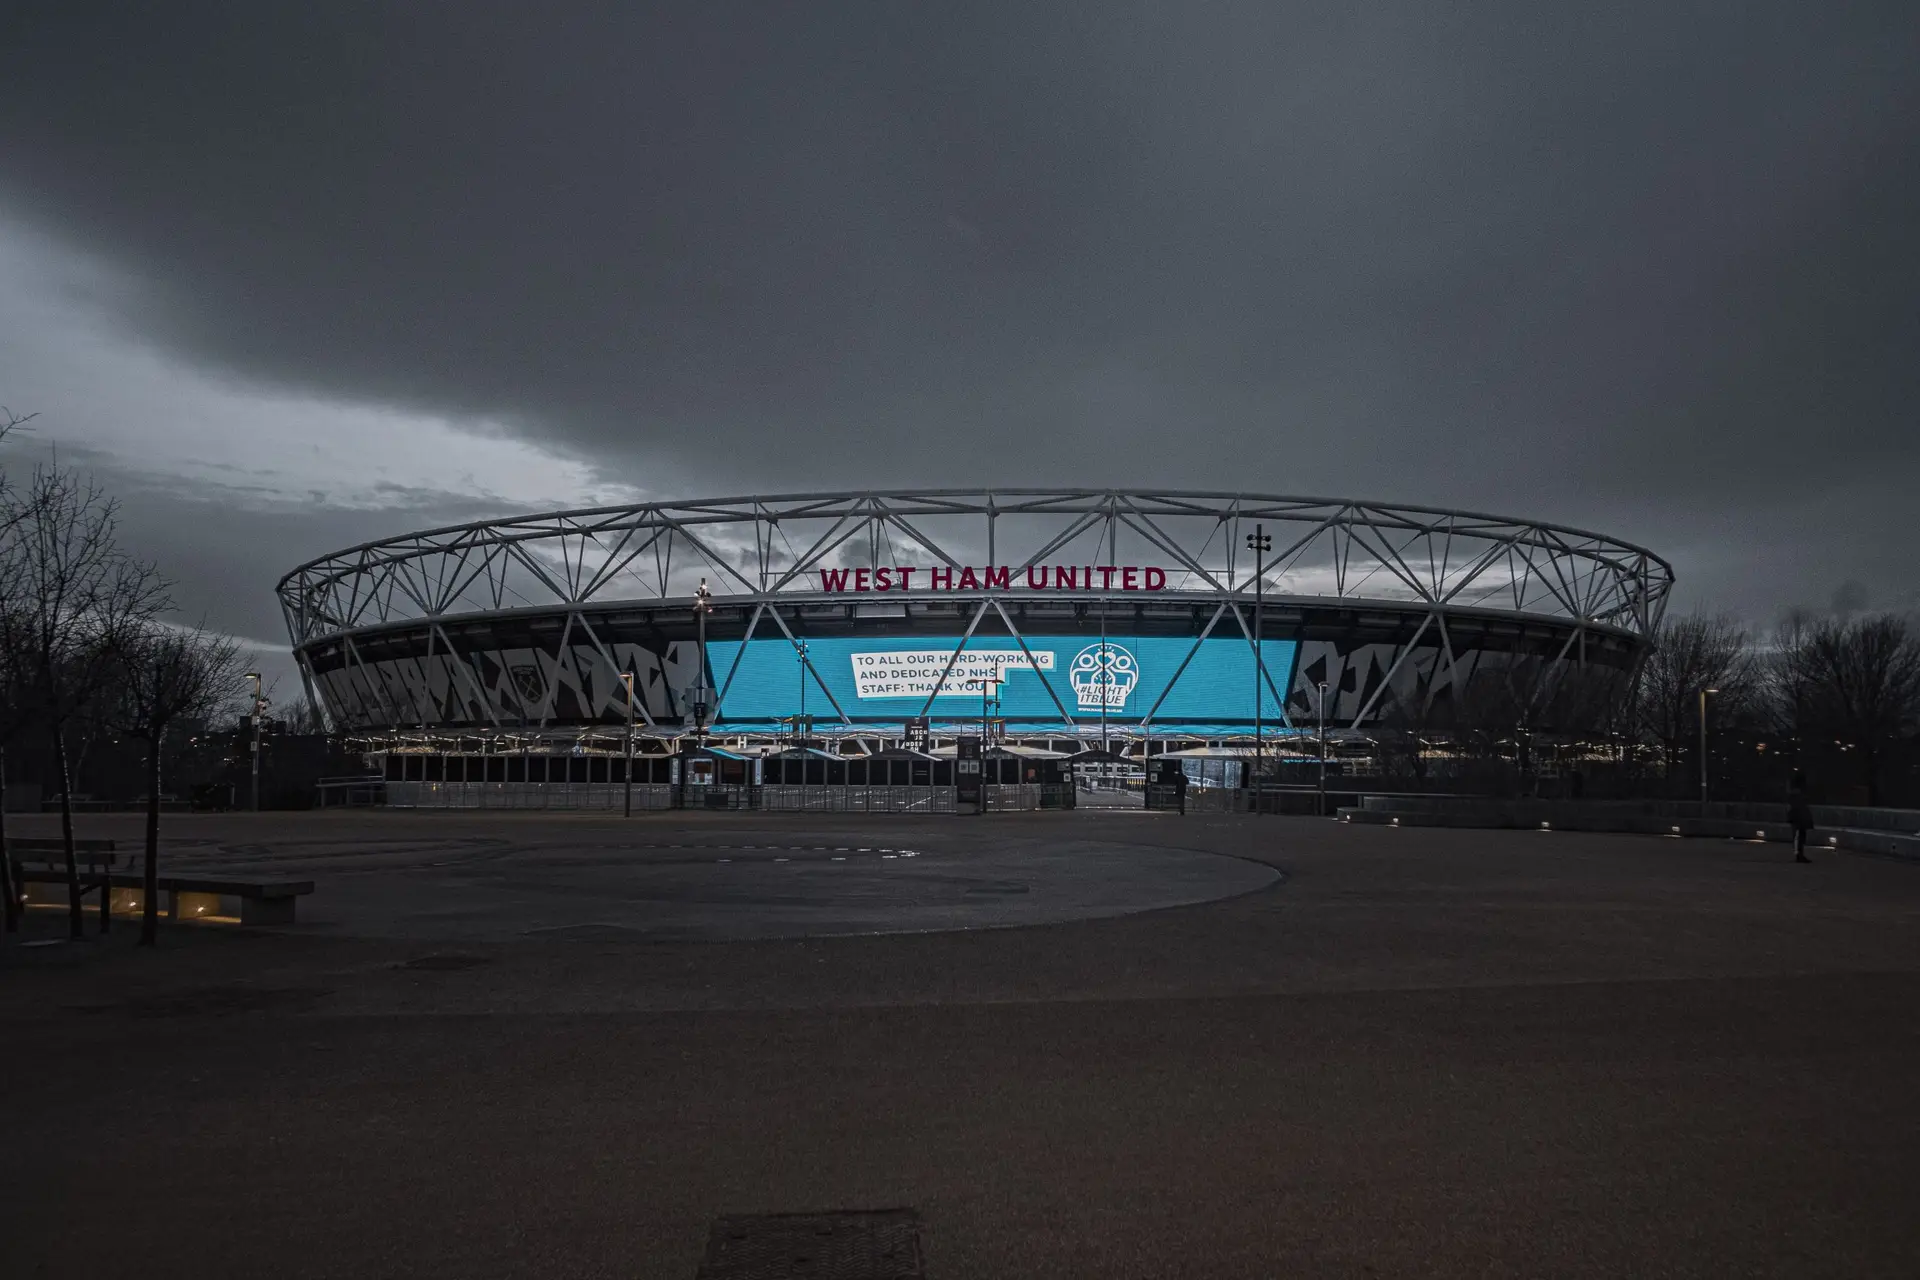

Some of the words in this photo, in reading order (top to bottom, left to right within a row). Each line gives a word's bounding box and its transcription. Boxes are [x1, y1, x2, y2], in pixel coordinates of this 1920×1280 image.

[820, 566, 916, 592] WEST
[931, 565, 1010, 591] HAM
[1027, 565, 1167, 591] UNITED
[857, 656, 874, 666] TO
[878, 655, 903, 665] ALL
[907, 655, 935, 664] OUR
[860, 669, 888, 680] AND
[891, 668, 965, 679] DEDICATED
[969, 668, 997, 678] NHS
[862, 683, 905, 694] STAFF:
[957, 682, 985, 692] YOU
